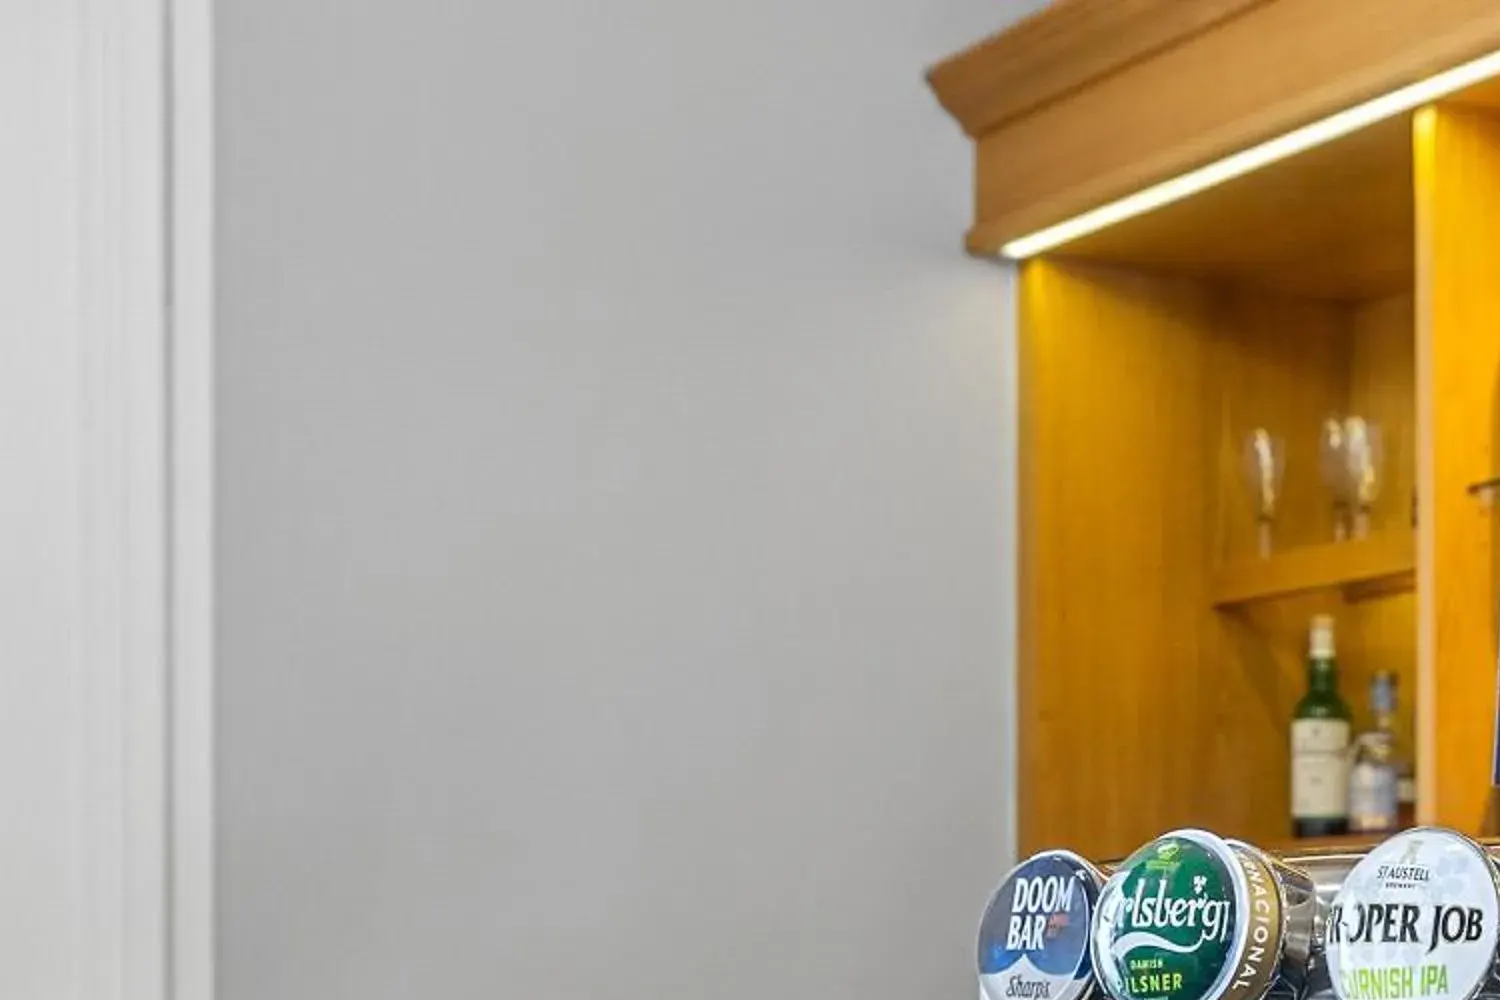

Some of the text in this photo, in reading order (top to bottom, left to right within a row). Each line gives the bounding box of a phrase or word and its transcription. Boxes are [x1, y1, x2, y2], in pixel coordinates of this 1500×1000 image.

[1012, 876, 1075, 912] DOOM
[1006, 915, 1047, 950] BAR
[1425, 904, 1483, 955] JOB
[1117, 972, 1182, 994] ILSNER
[1420, 964, 1449, 996] IPA
